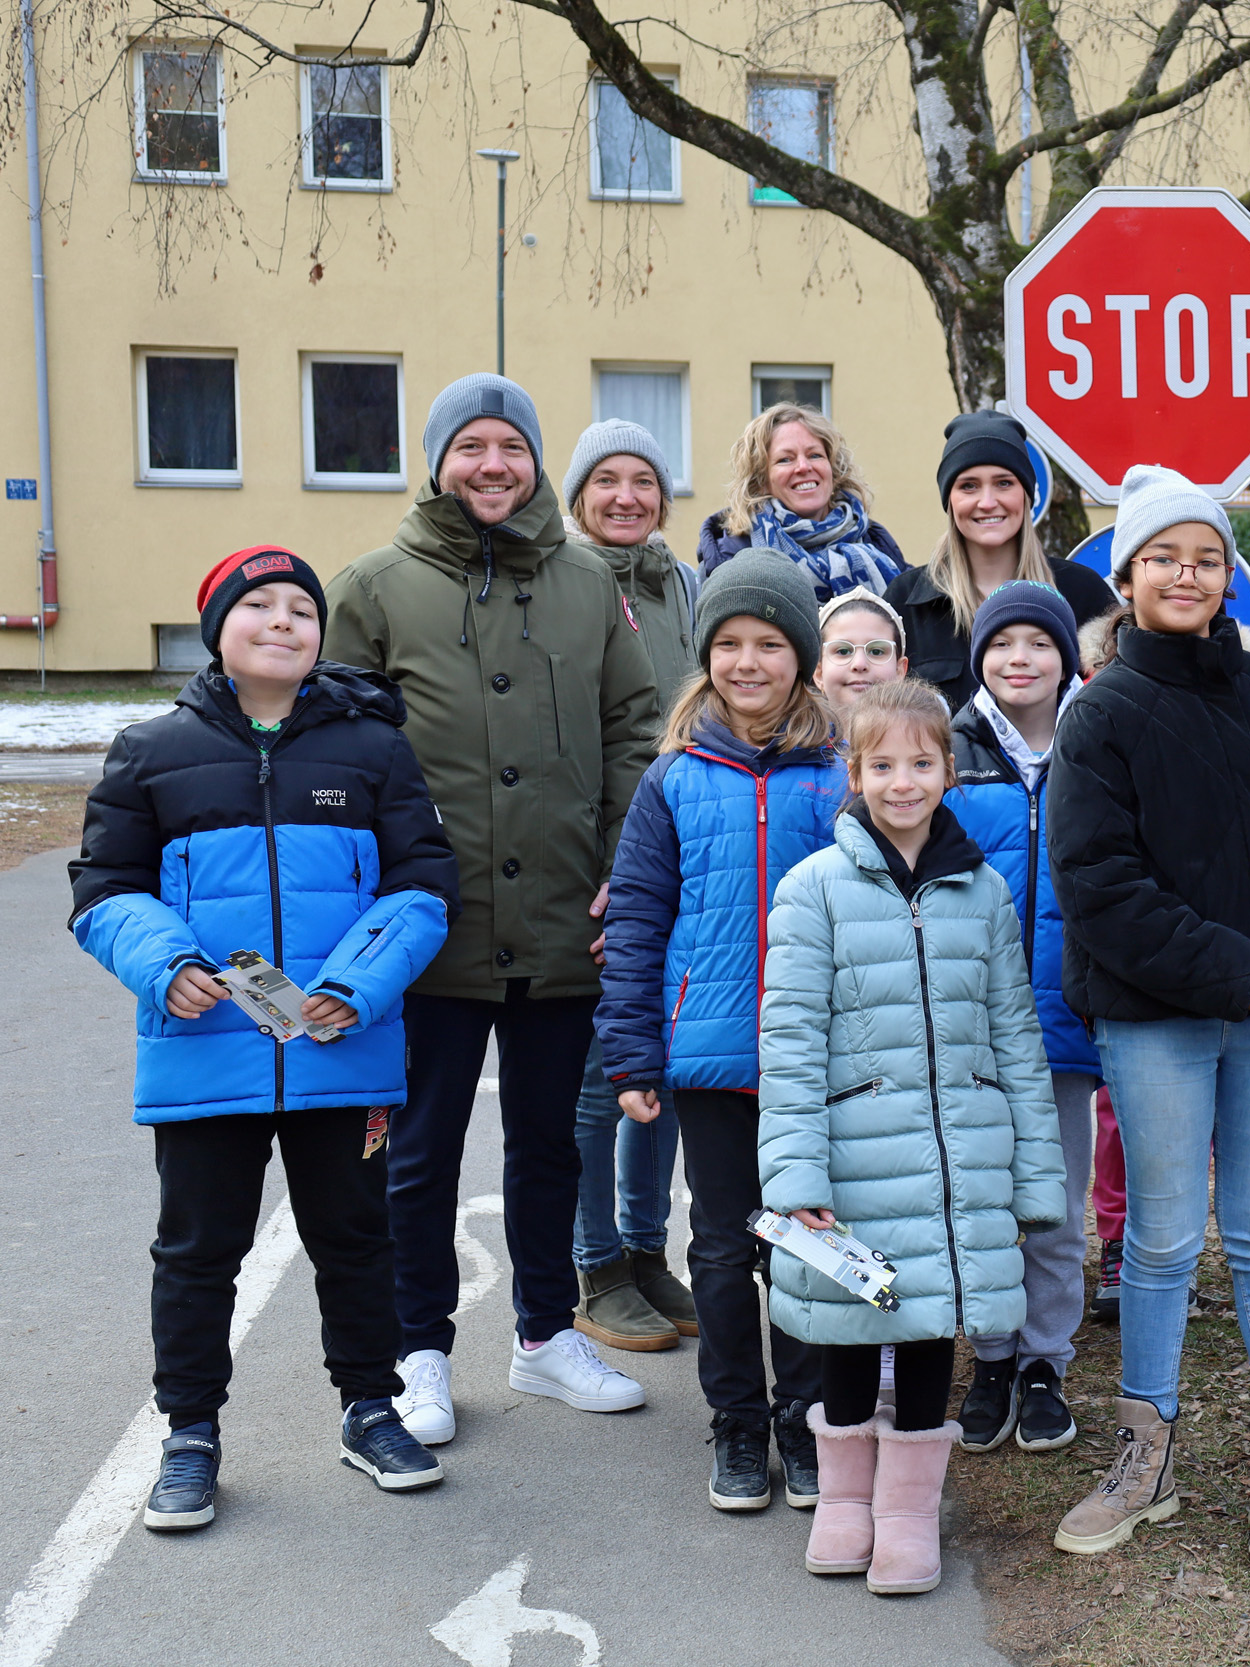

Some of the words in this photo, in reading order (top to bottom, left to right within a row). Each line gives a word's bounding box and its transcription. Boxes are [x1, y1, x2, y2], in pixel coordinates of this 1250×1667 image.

[312, 789, 346, 797] NORTH
[320, 797, 346, 805] VILLE
[363, 1410, 388, 1424] GEOX
[186, 1439, 214, 1449] GEOX
